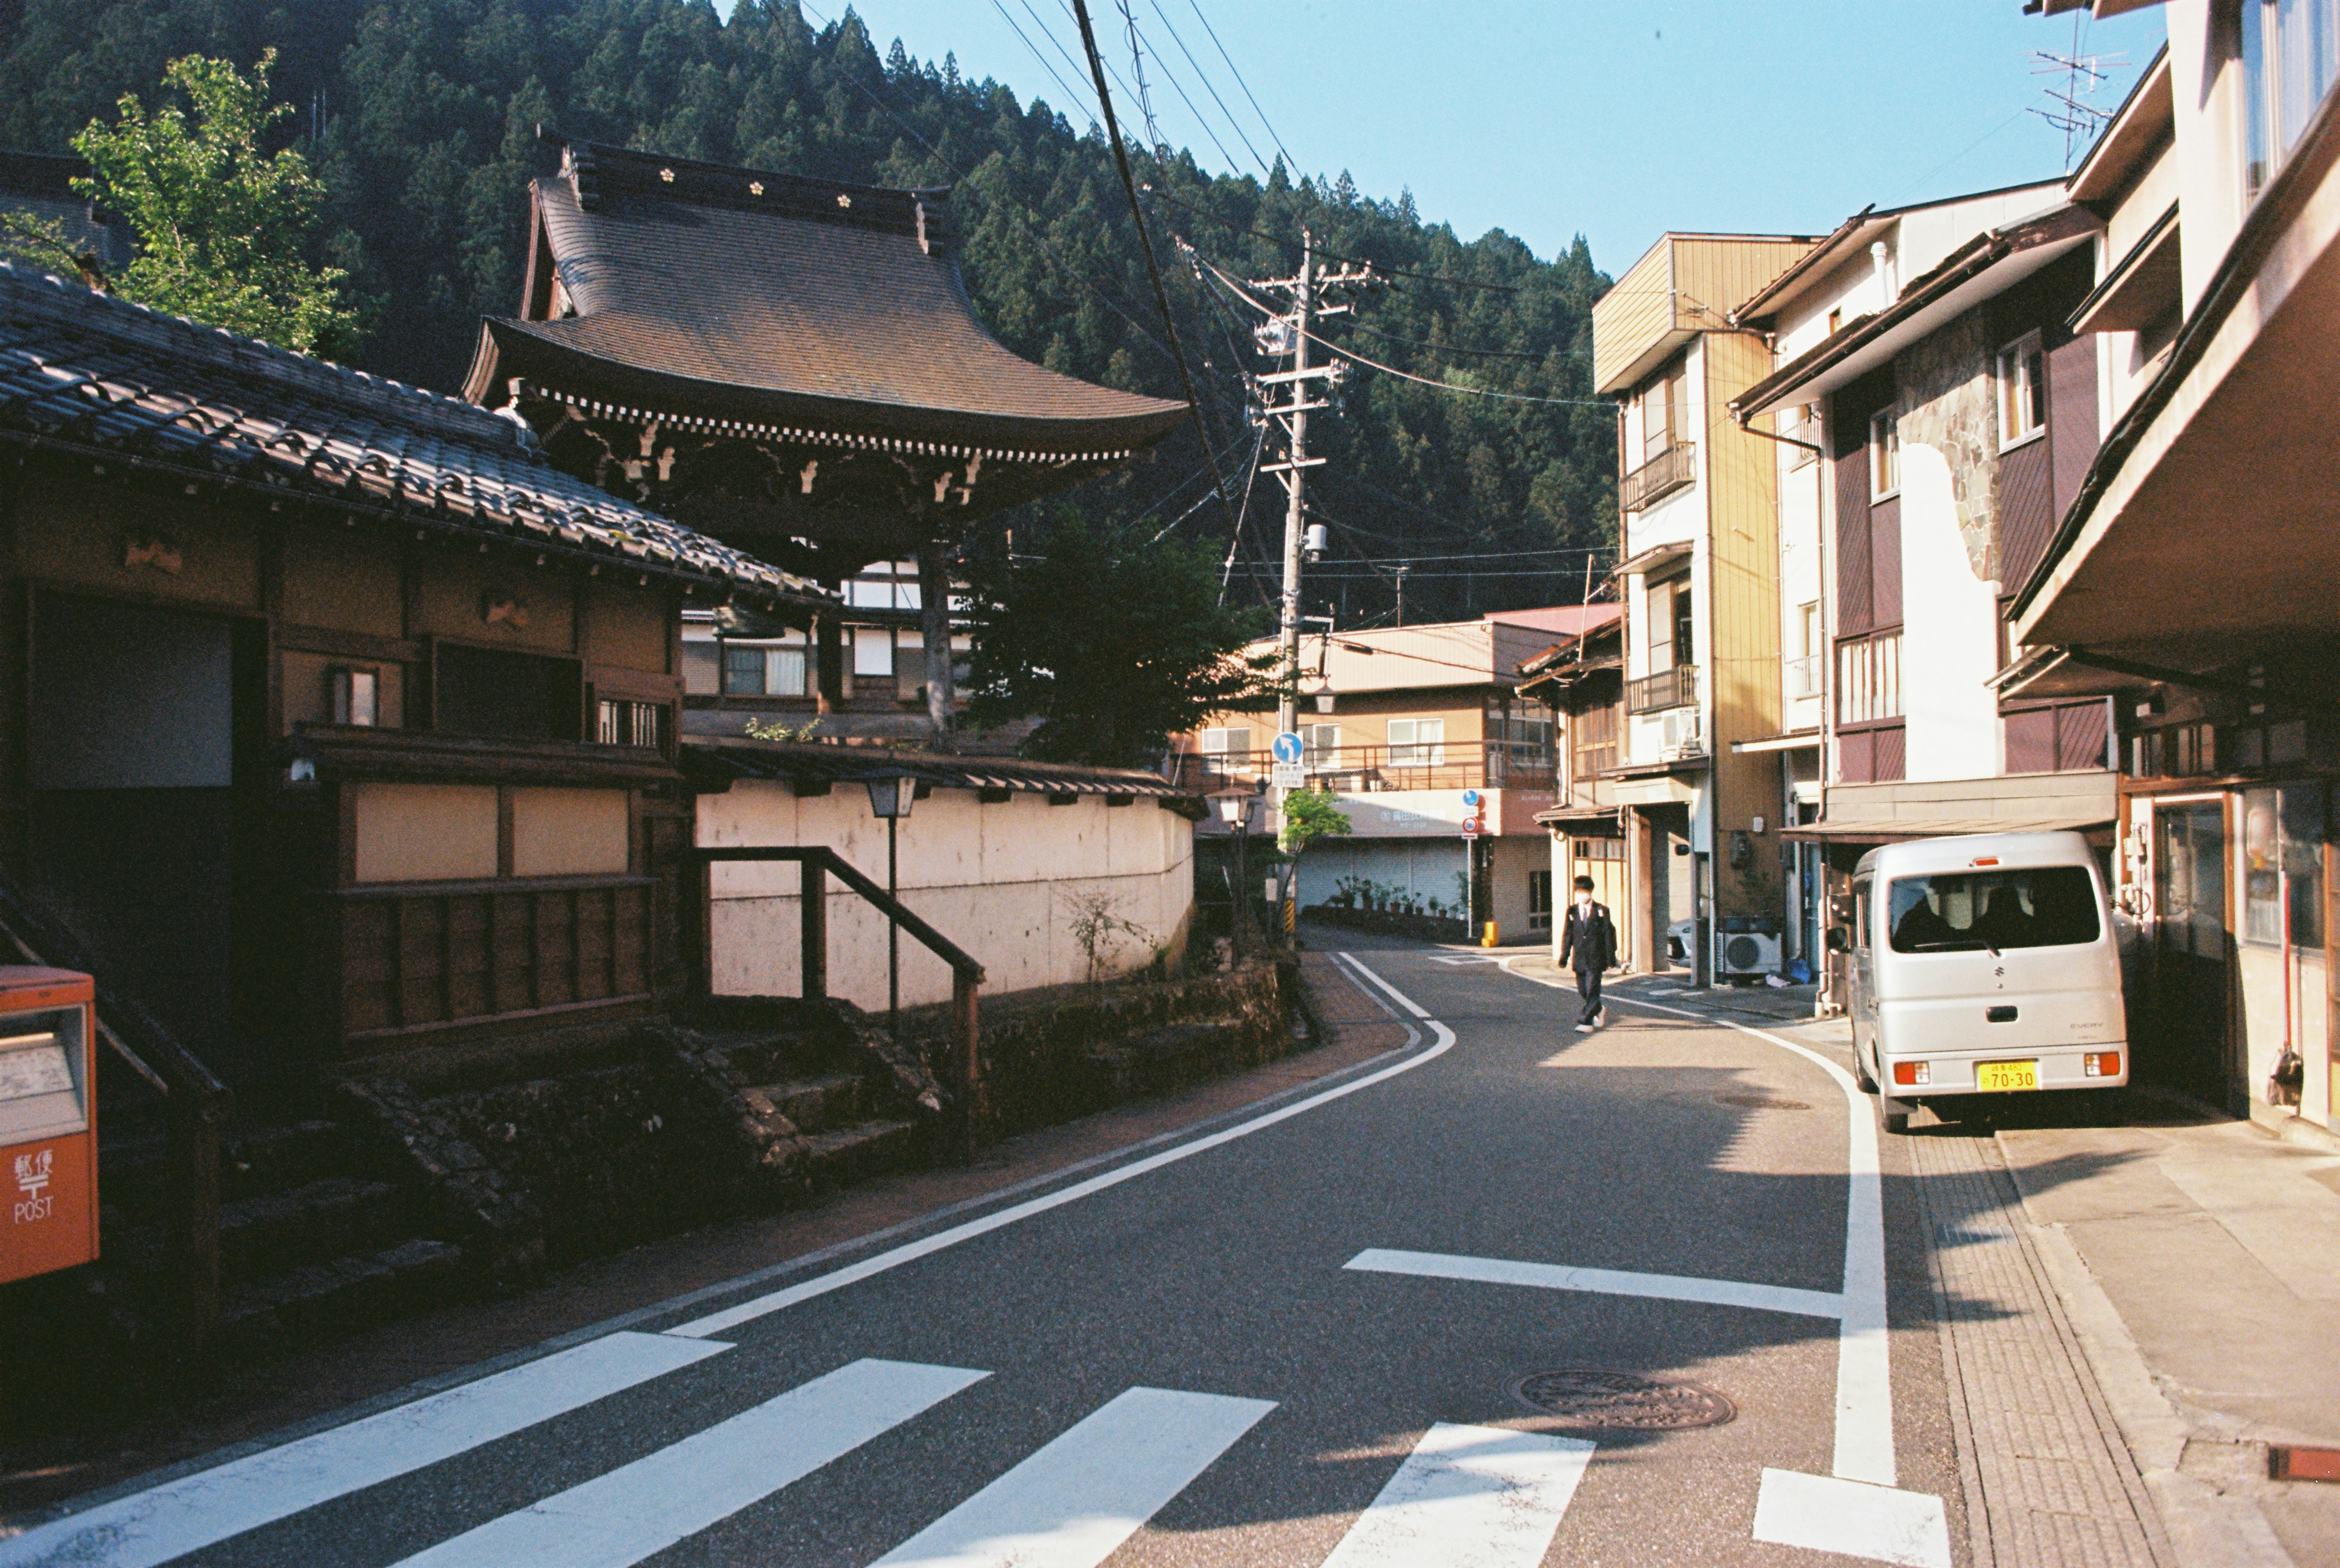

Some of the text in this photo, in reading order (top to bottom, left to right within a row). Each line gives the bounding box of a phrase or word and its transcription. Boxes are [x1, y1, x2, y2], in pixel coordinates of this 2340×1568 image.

[1991, 1072, 2033, 1087] 70-30
[15, 1149, 53, 1179] 郵便
[15, 1196, 53, 1224] POST
